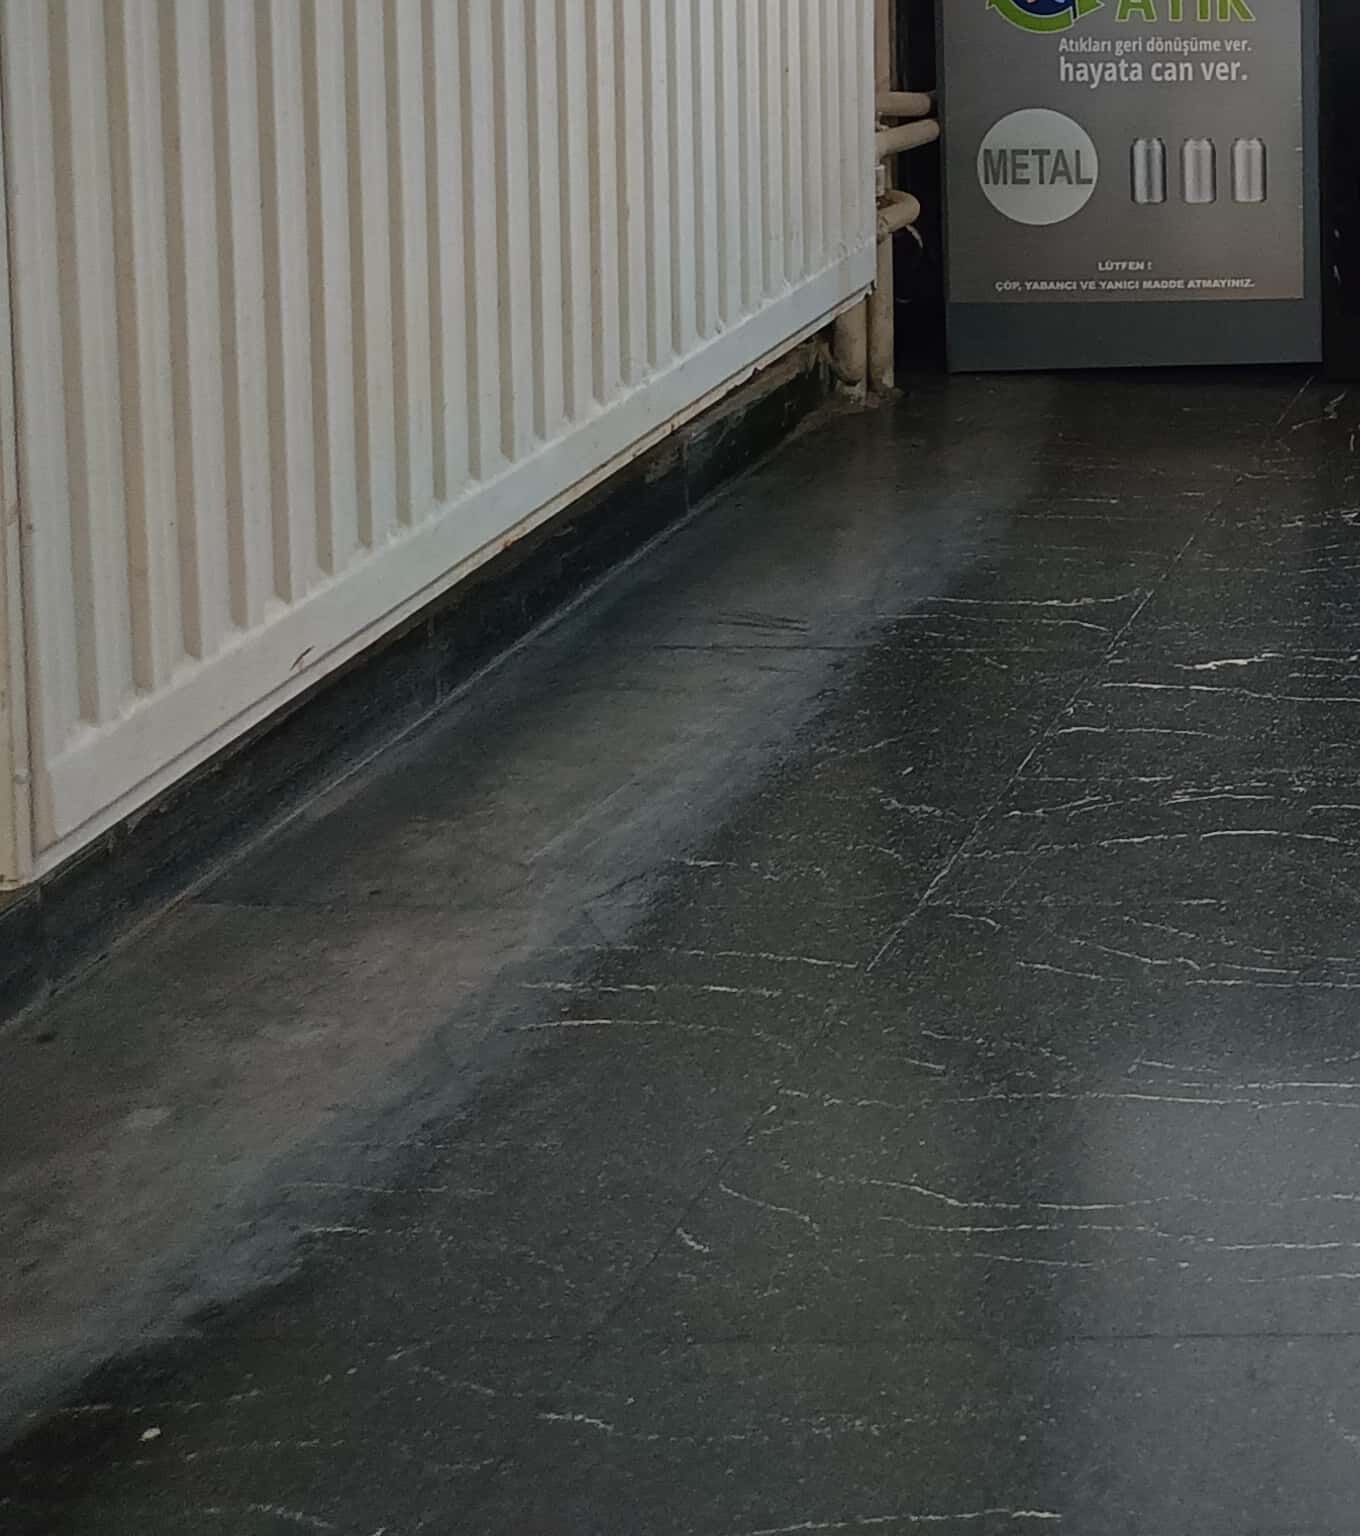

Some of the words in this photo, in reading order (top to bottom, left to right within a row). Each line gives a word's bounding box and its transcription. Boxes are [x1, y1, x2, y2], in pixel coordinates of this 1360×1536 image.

[1059, 37, 1112, 52] Atıkları
[1115, 37, 1142, 55] geri
[1146, 37, 1221, 56] dönüşüme
[1224, 40, 1252, 52] ver.
[1059, 57, 1143, 88] hayata
[1150, 61, 1194, 81] can
[1201, 60, 1248, 81] ver.
[983, 149, 1093, 185] METAL
[1098, 260, 1145, 271] LÜTFEN
[1025, 281, 1077, 290] YABANCI
[1080, 281, 1096, 290] VE
[1100, 280, 1140, 290] YANICI
[1142, 280, 1185, 289] MADDE
